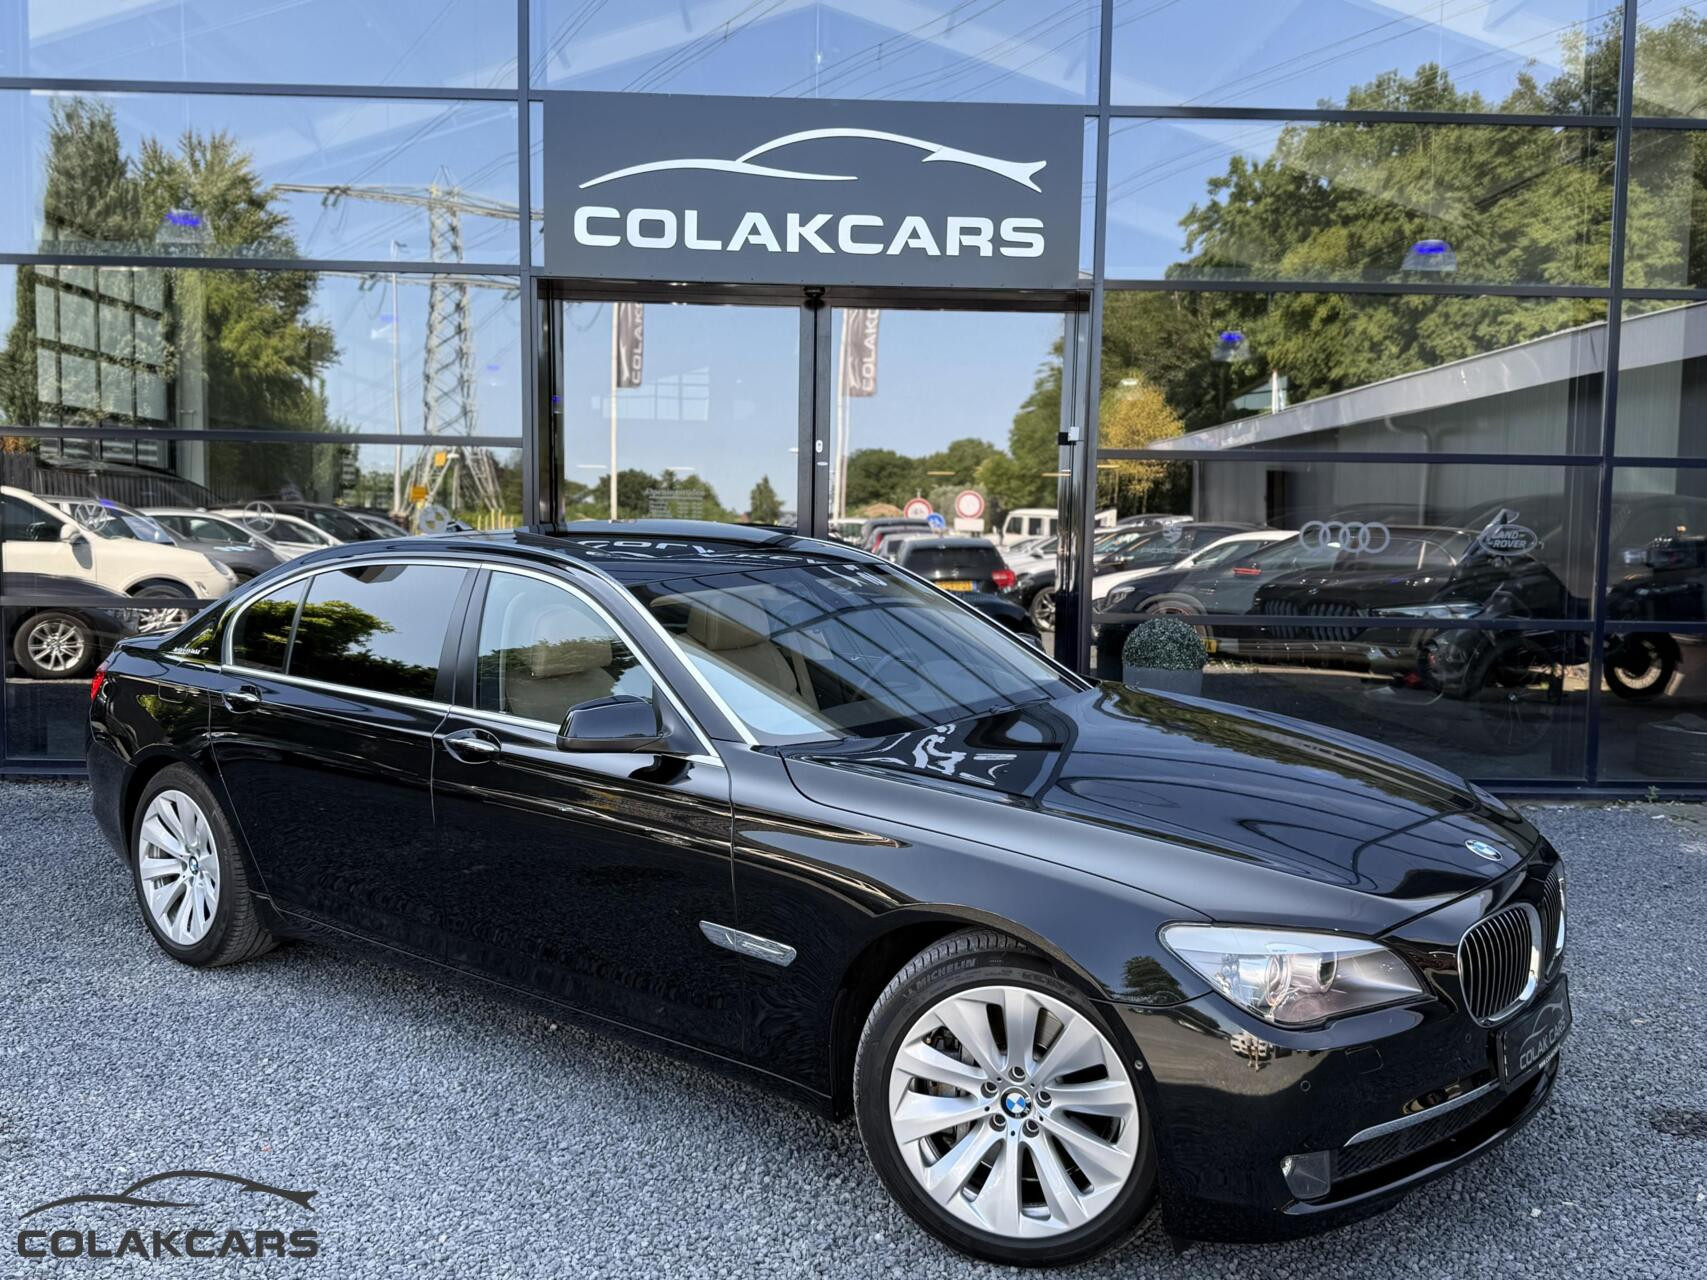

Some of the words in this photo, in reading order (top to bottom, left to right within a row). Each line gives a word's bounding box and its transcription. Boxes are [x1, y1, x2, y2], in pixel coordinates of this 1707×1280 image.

[573, 206, 1045, 257] COLAKCARS
[1492, 539, 1527, 548] ROVER
[916, 958, 976, 990] MICHELIN
